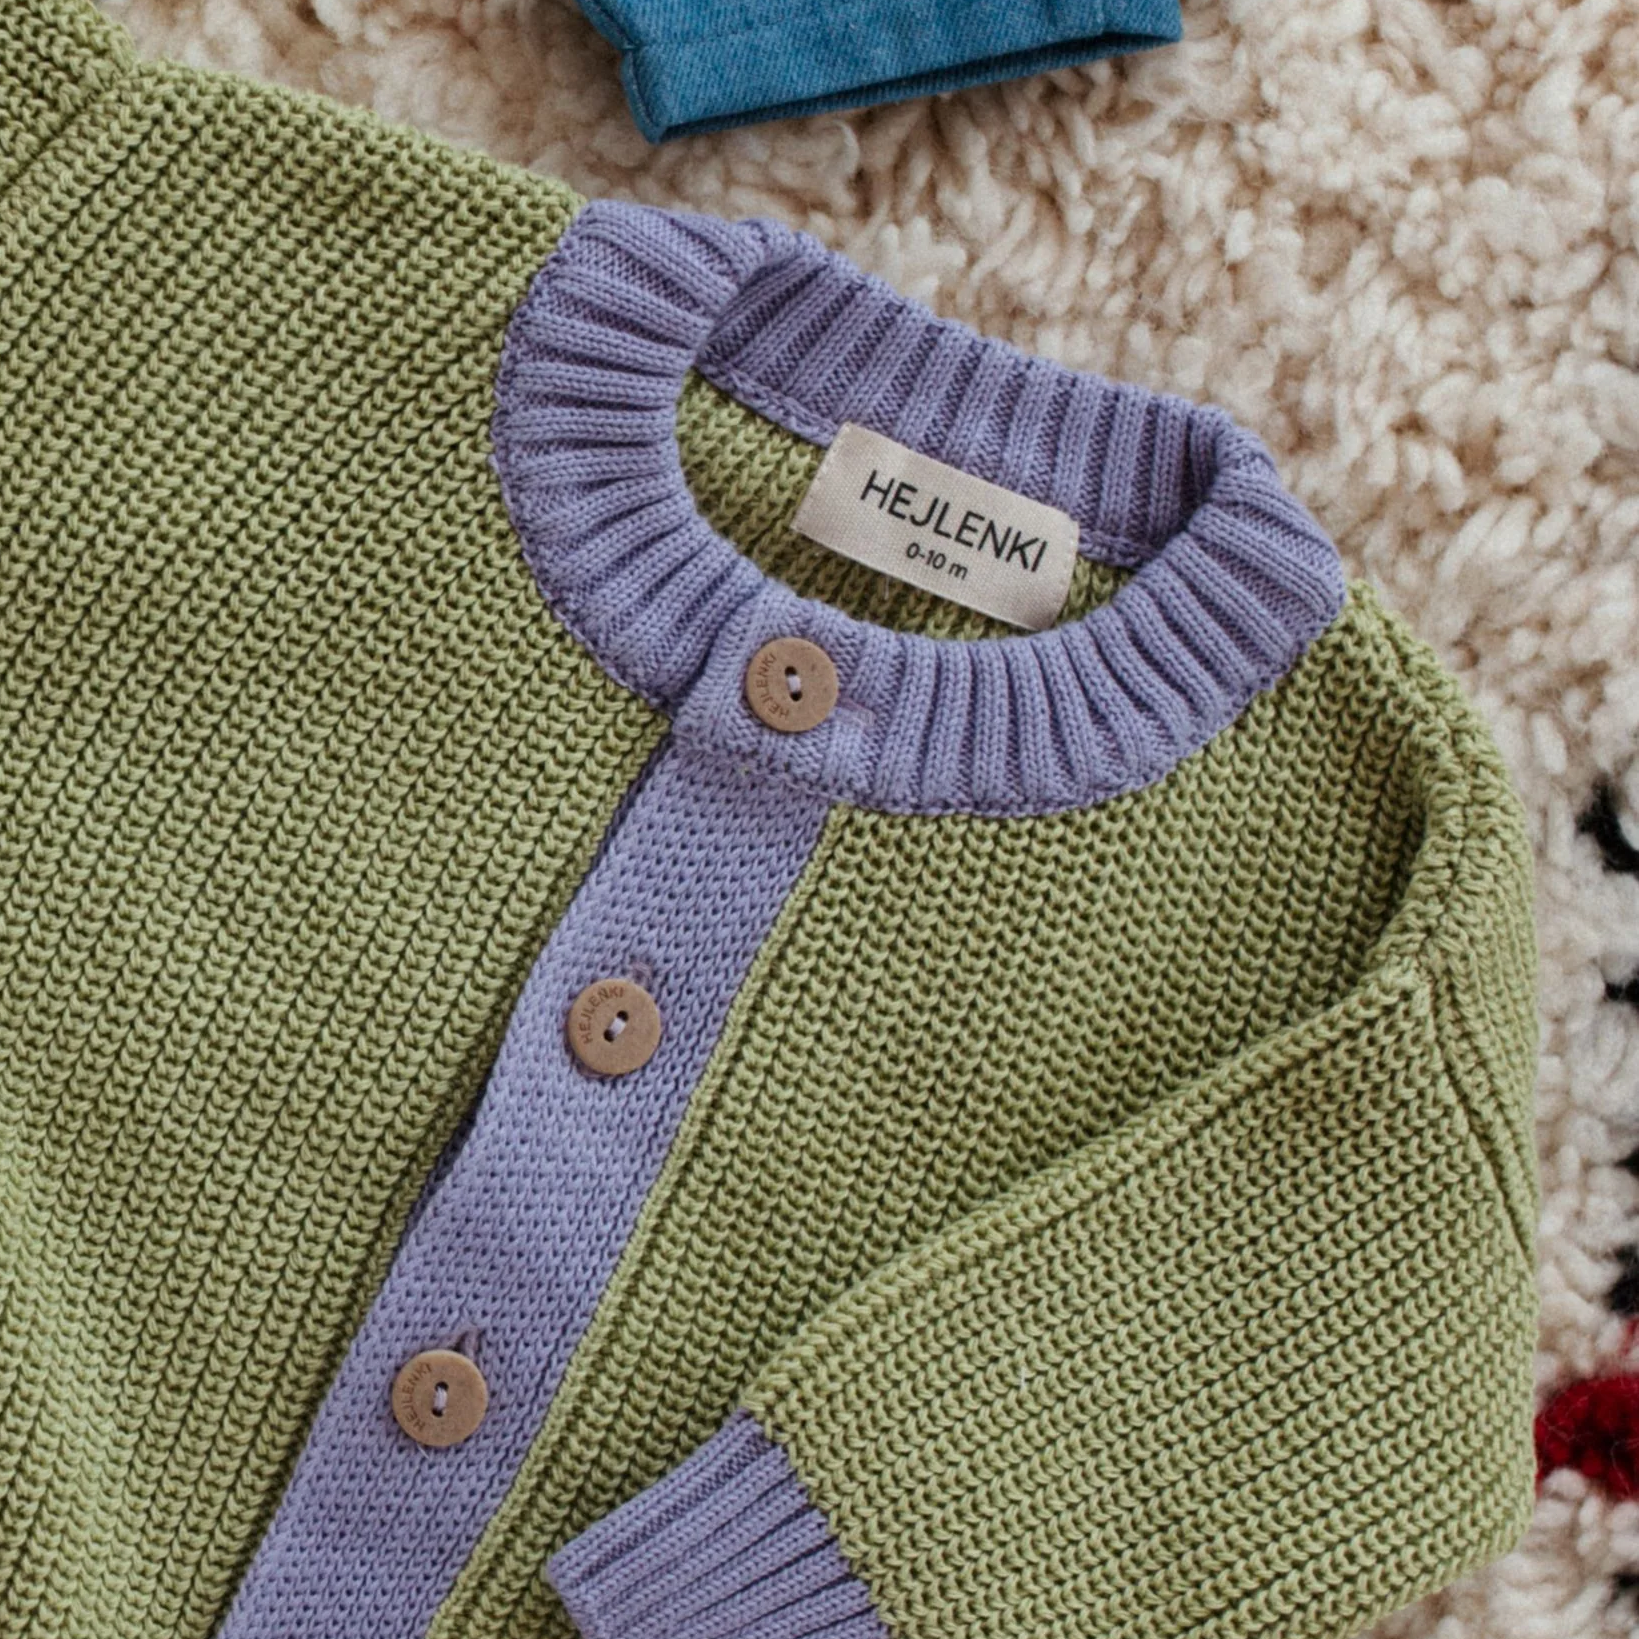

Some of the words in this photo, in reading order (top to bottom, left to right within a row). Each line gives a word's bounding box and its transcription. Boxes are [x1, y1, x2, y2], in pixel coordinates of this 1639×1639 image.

[861, 469, 1047, 572] HEJLENKI
[906, 542, 947, 570] 0-10
[948, 561, 968, 580] m
